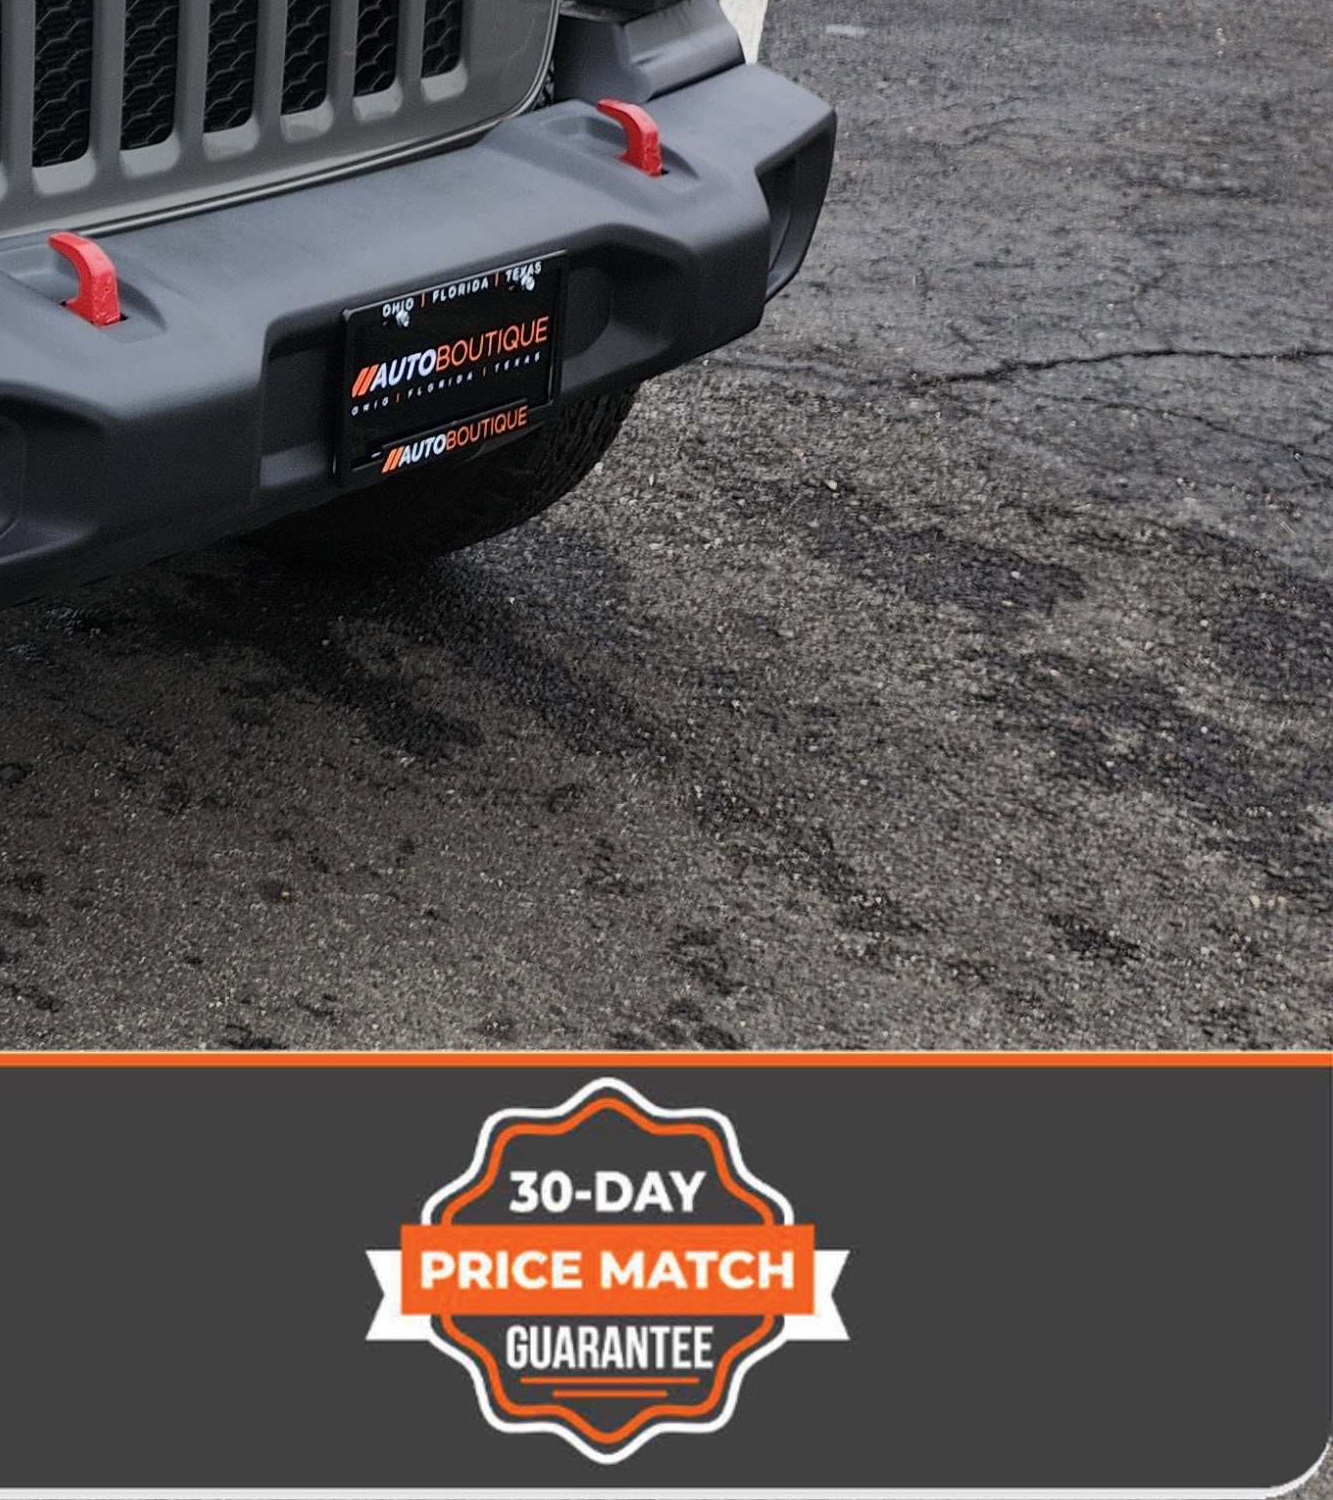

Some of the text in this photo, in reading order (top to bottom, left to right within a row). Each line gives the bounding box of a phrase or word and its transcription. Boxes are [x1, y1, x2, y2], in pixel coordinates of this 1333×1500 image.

[383, 260, 542, 318] OHIO FLORIDA TEXAS
[351, 350, 541, 417] OHIO FLORIDA TEXAS
[369, 315, 550, 392] AUTOBOUTIQUE
[399, 405, 528, 468] AUTOBOUTIQUE
